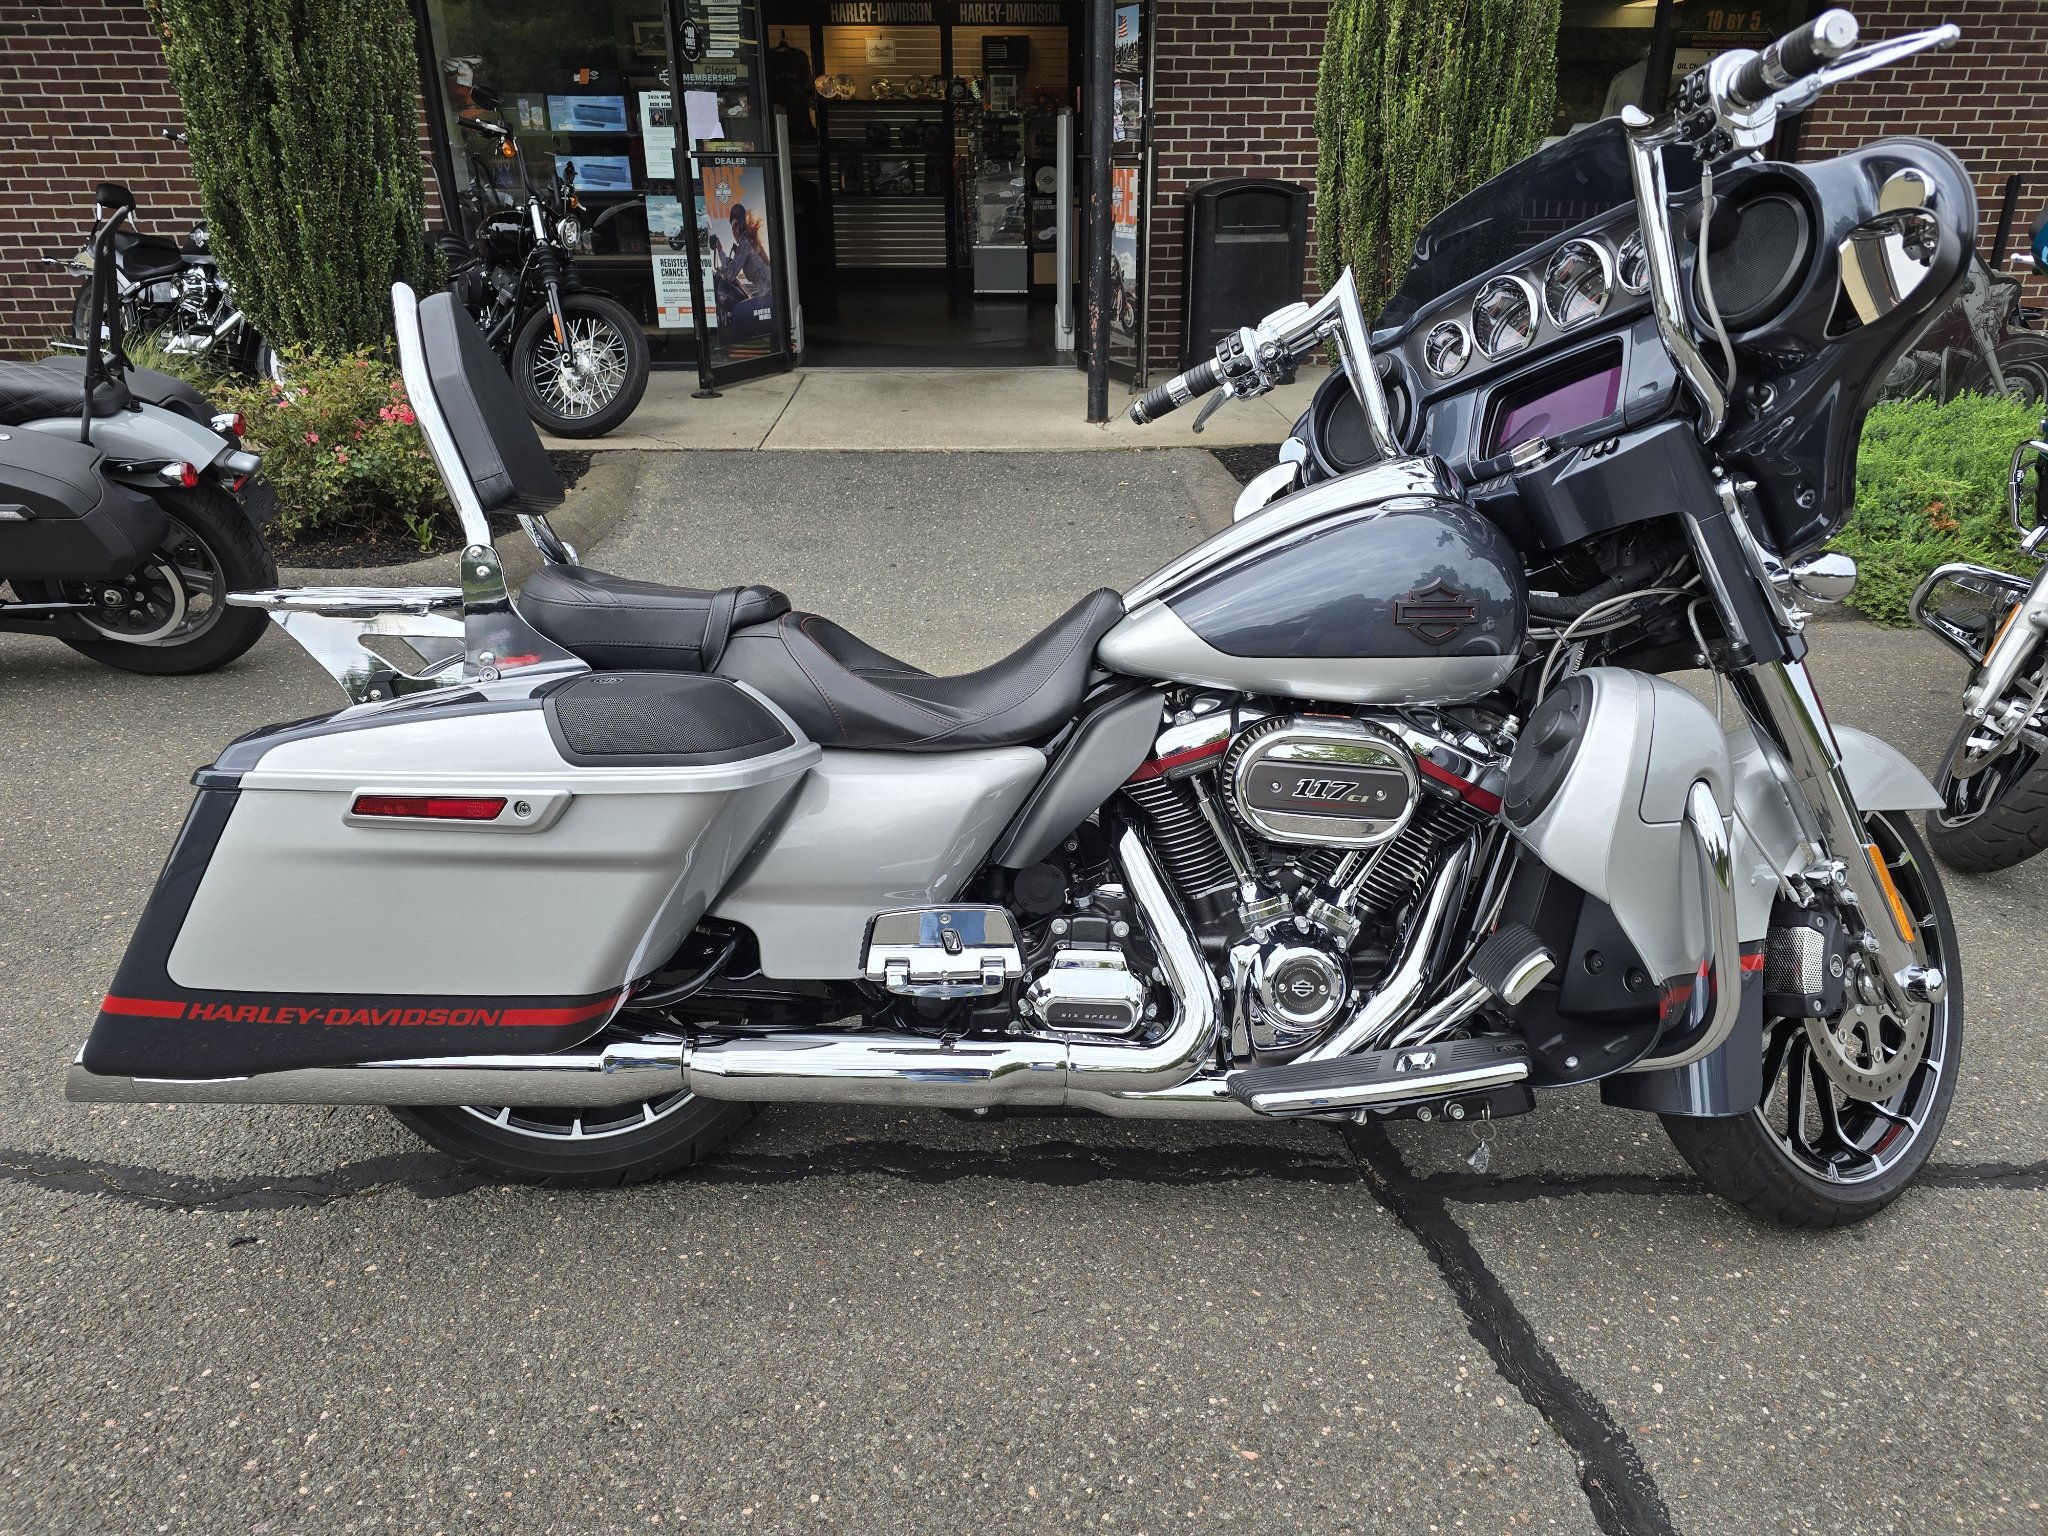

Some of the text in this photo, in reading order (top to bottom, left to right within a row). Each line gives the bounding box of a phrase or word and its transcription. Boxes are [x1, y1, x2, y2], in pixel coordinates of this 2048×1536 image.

[831, 2, 933, 23] HARLEY-DAVIDSON
[960, 3, 1061, 23] HARLEY-DAVIDSON
[1707, 10, 1762, 31] 10 BY 5
[682, 73, 737, 81] MEMBERSHIP
[704, 66, 737, 75] Closed
[715, 157, 747, 165] DEALER
[659, 258, 712, 268] REGISTER YOU
[661, 268, 684, 277] CHANCE
[1292, 778, 1370, 803] 117 CI
[187, 1001, 501, 1027] HARLEY-DAVIDSON
